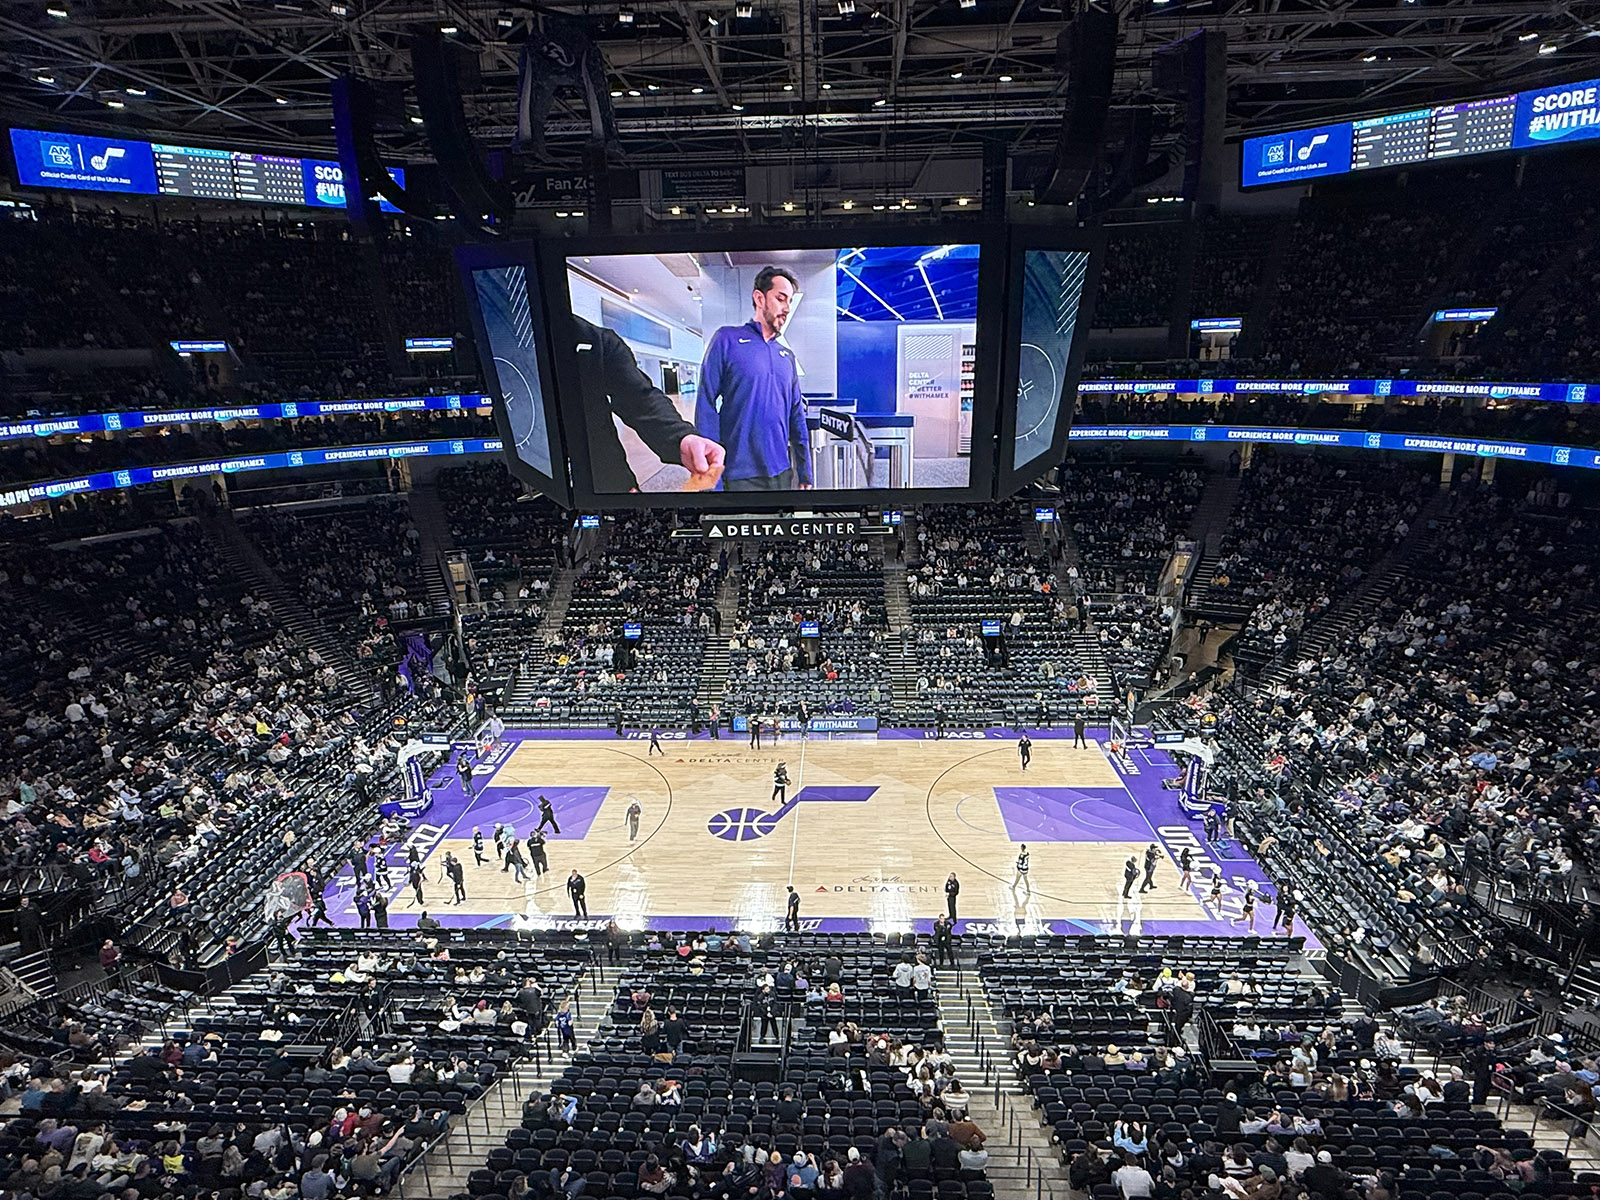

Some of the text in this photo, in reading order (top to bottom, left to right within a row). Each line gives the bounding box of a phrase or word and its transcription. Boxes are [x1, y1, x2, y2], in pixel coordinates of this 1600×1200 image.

[1532, 88, 1597, 113] SCORE
[546, 178, 572, 190] Fan
[1235, 383, 1280, 391] EXPERIENCE
[1280, 383, 1302, 391] MORE
[1416, 384, 1466, 394] EXPERIENCE
[1466, 385, 1489, 394] MORE
[320, 403, 363, 412] EXPERIENCE
[363, 402, 383, 410] MORE
[143, 412, 191, 423] EXPERIENCE
[191, 411, 213, 419] MORE
[9, 425, 33, 435] MORE
[821, 415, 850, 434] ENTRY
[1228, 430, 1272, 440] EXPERIENCE
[1272, 432, 1294, 440] MORE
[1404, 438, 1453, 450] EXPERIENCE
[1453, 441, 1476, 451] MORE
[325, 450, 367, 460] EXPERIENCE
[367, 448, 387, 457] MORE
[152, 465, 199, 478] EXPERIENCE
[199, 463, 221, 472] MORE
[28, 486, 46, 497] ORE
[727, 523, 855, 537] DELTA CENTER
[790, 720, 812, 729] MOE
[812, 720, 859, 729] #WITHAMEX
[834, 885, 939, 893] DELTA CENT
